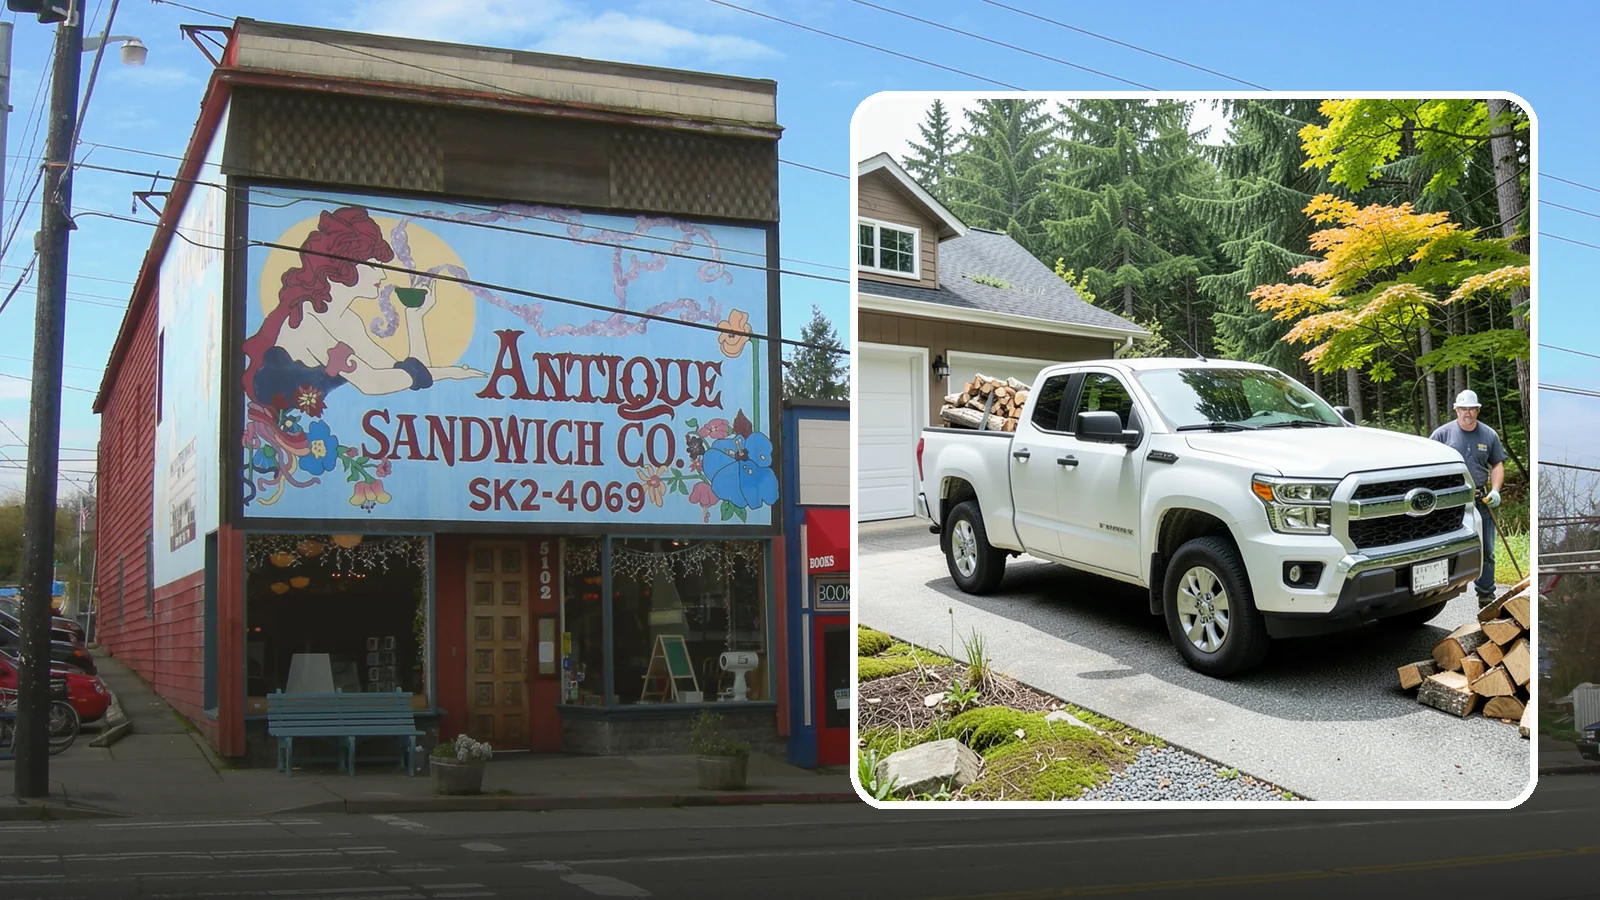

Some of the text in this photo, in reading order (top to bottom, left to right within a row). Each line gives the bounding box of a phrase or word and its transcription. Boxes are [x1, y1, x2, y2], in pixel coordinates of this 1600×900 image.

[477, 329, 723, 421] ANTIQUE
[362, 409, 685, 468] SANDWICH CO.
[468, 478, 645, 513] SK2-4069
[540, 541, 551, 600] 5102
[809, 555, 835, 569] BOOKS
